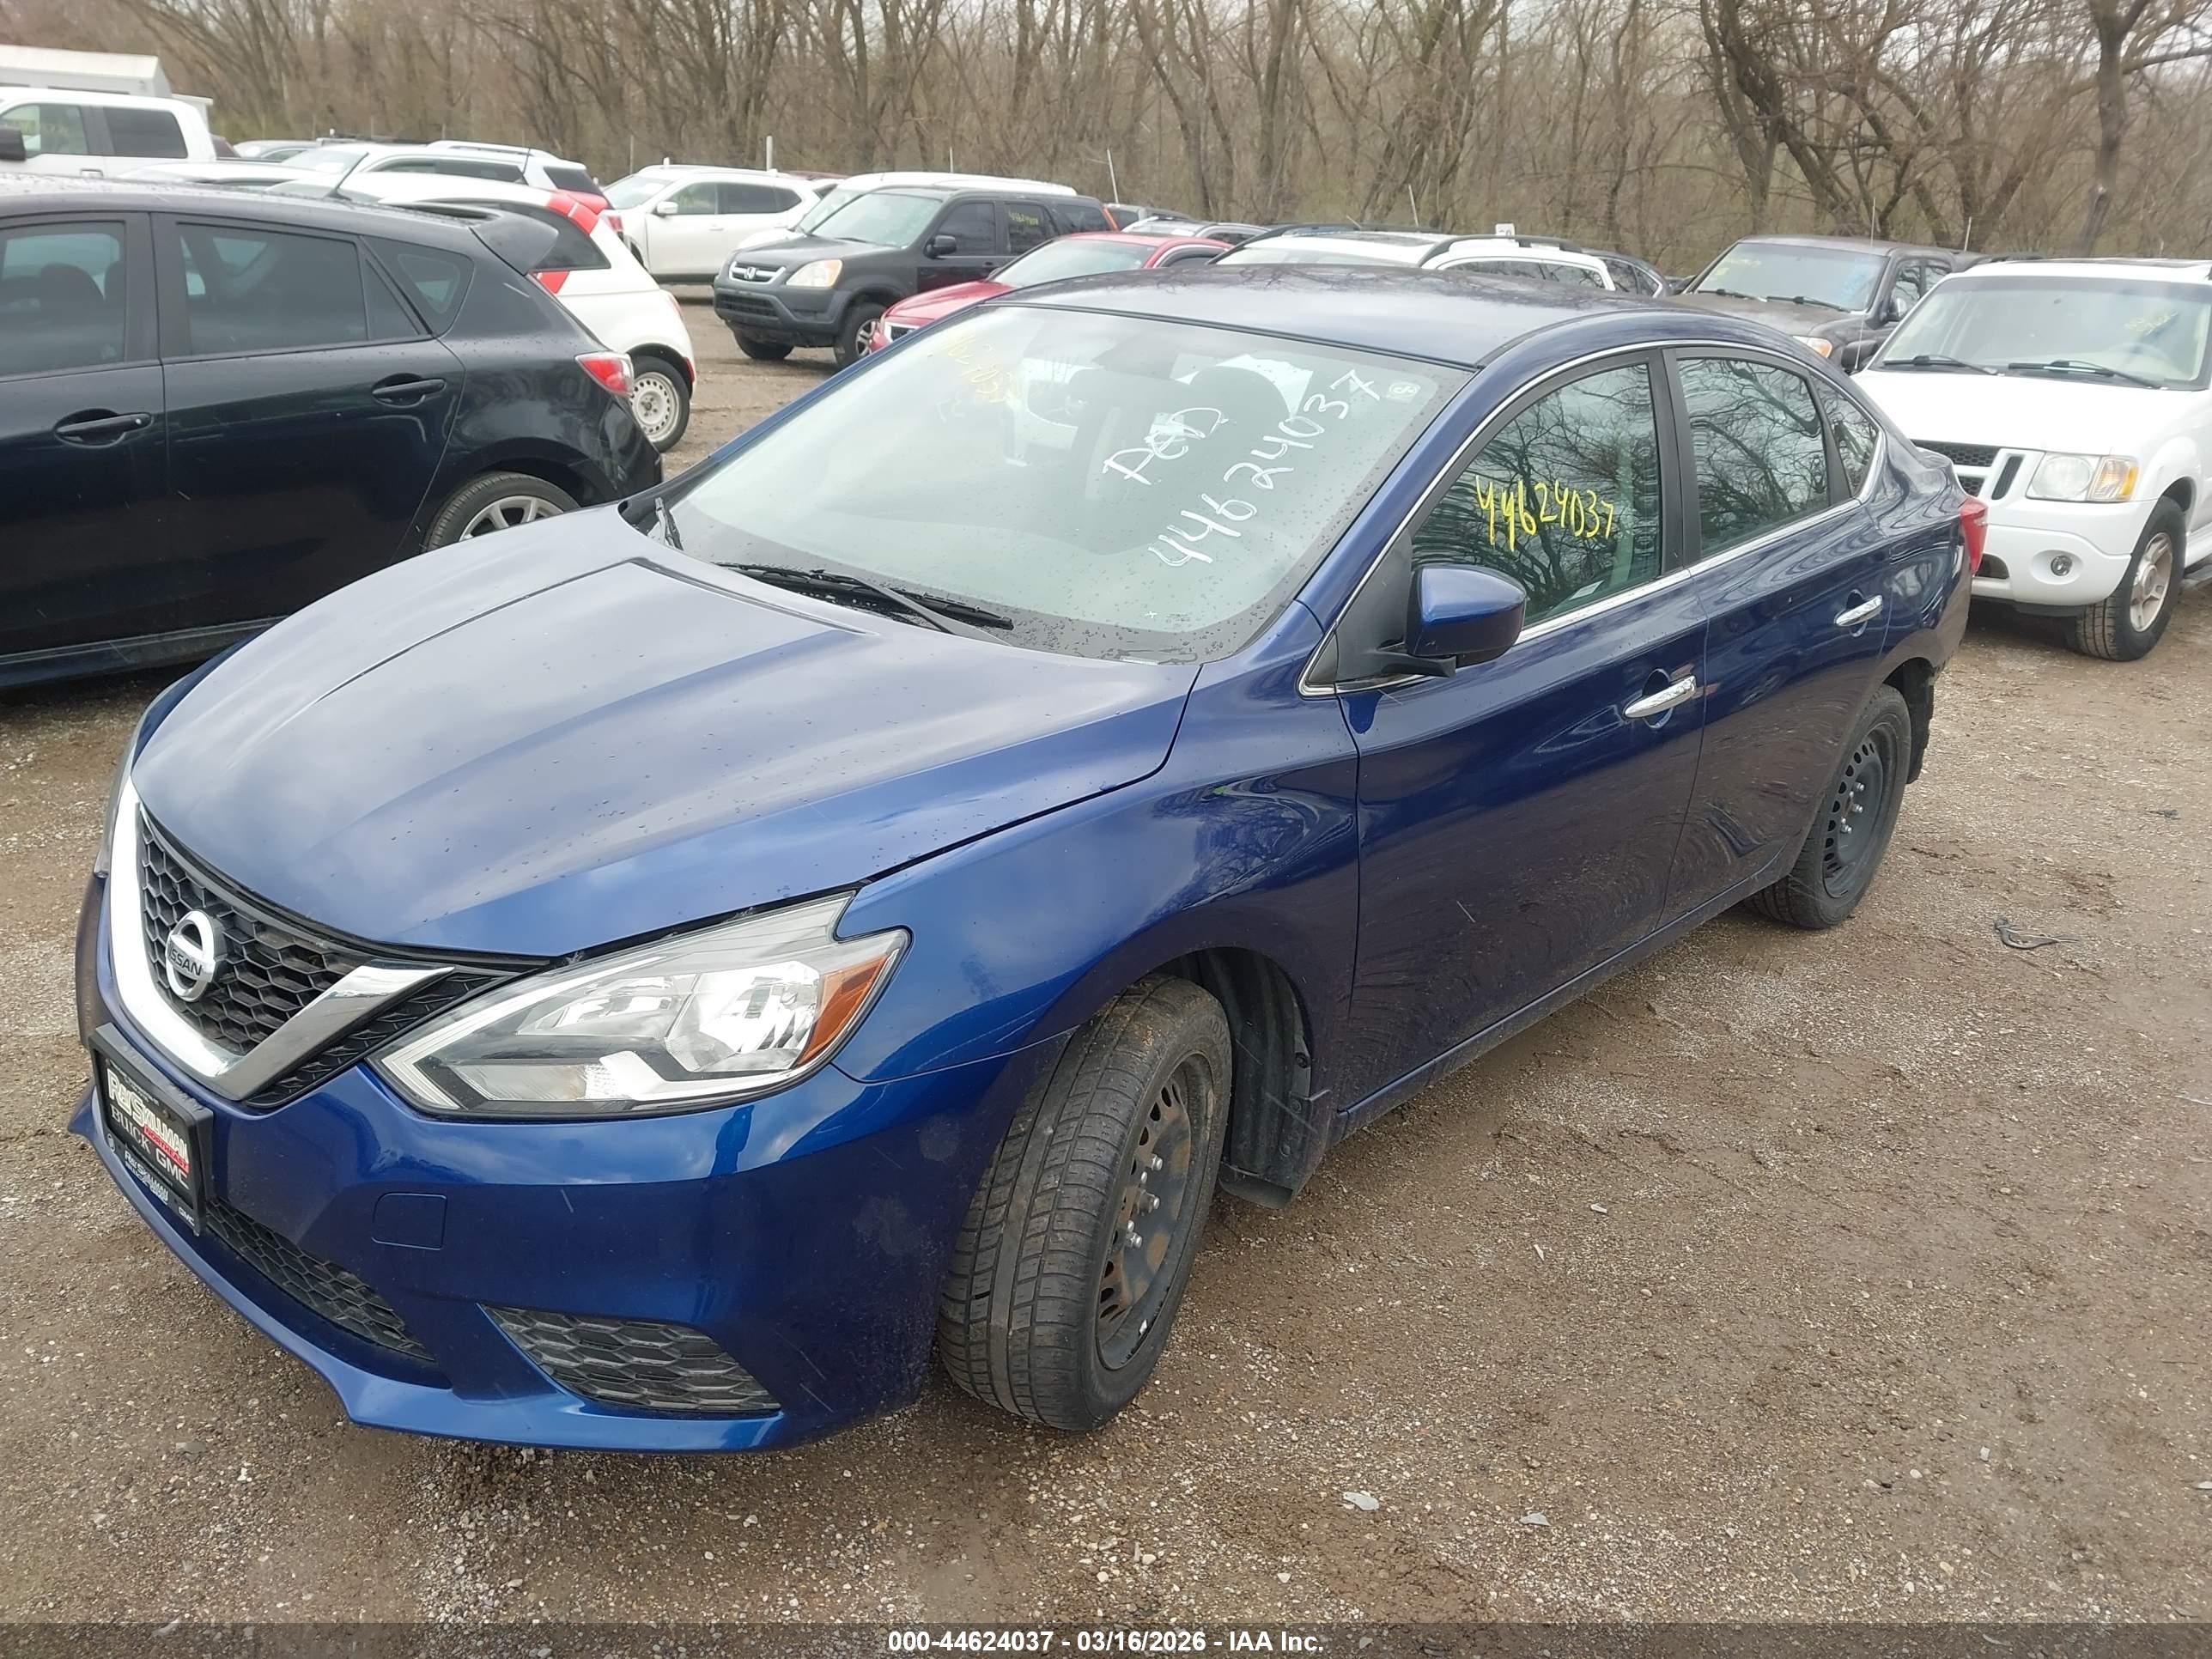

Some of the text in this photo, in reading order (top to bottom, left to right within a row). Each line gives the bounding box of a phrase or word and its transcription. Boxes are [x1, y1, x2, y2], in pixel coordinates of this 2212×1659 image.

[1475, 474, 1614, 553] 44624037
[110, 1103, 151, 1155] BUICK
[155, 1147, 190, 1190] GMC
[145, 1127, 187, 1169] NORTHEAST
[178, 1206, 196, 1227] GMC
